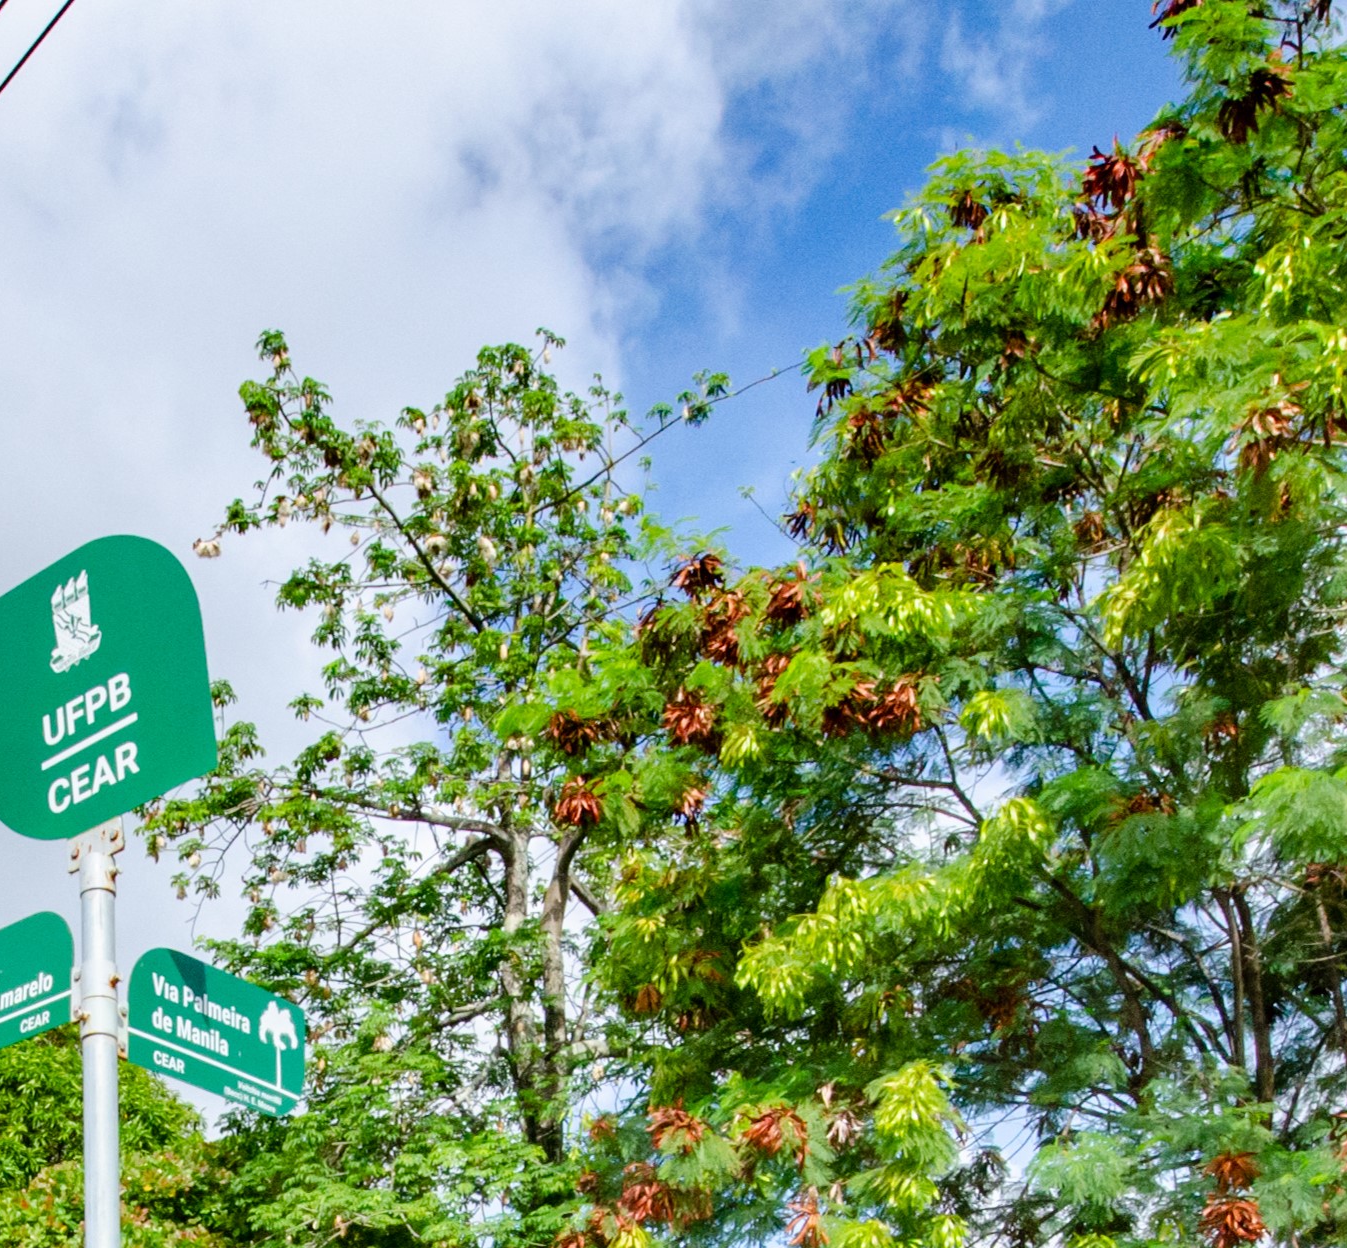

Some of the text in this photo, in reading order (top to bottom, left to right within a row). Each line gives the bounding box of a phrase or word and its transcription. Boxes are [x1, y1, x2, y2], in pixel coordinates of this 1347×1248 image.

[42, 672, 132, 746] UFPB
[47, 741, 140, 814] CEAR
[20, 1010, 50, 1034] CEAR
[151, 1006, 229, 1057] de Manila
[152, 972, 251, 1035] Via Palmeira
[153, 1050, 185, 1074] CEAR
